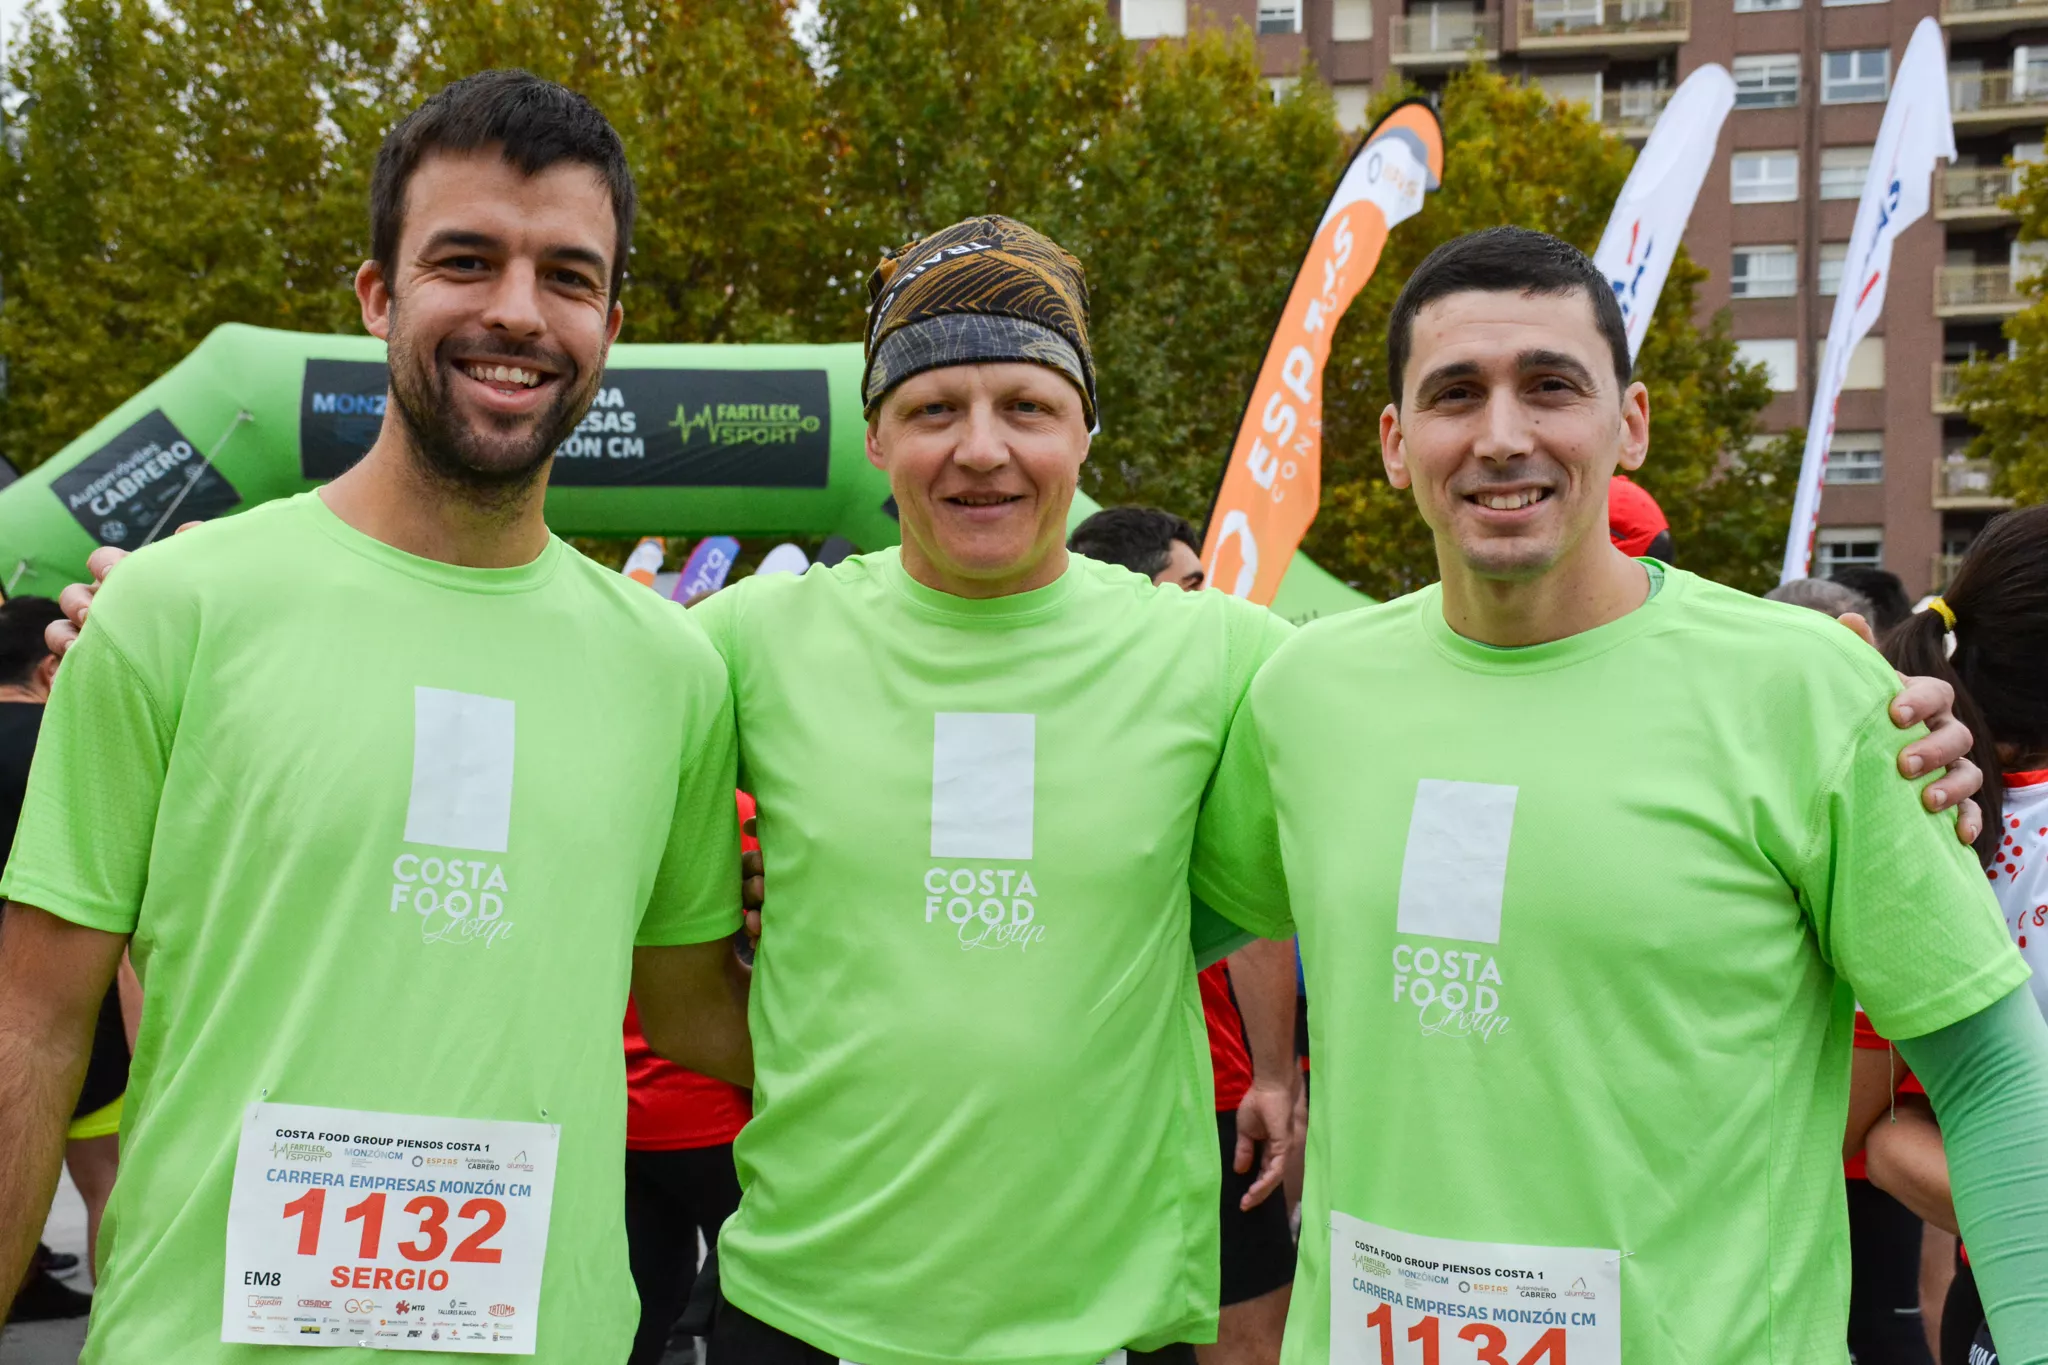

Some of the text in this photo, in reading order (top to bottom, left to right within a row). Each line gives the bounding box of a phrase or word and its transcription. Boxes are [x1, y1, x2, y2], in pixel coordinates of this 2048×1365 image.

[717, 404, 800, 420] FARTLECK
[607, 436, 645, 459] CM
[721, 428, 799, 445] SPORT
[90, 440, 193, 516] CABRERO
[393, 853, 508, 892] COSTA
[924, 867, 1038, 897] COSTA
[390, 884, 504, 921] FOOD
[925, 895, 1034, 926] FOOD
[422, 903, 515, 949] Group
[958, 911, 1046, 953] Group
[1392, 944, 1503, 985] COSTA
[1394, 973, 1499, 1015] FOOD
[1419, 995, 1511, 1044] Group
[276, 1129, 490, 1152] COSTA FOOD GROUP PIENSOS COSTA 1
[290, 1143, 325, 1153] FARTLECK
[290, 1153, 324, 1163] SPORT
[426, 1157, 458, 1165] ESPIAS
[468, 1163, 500, 1171] CABRERO
[266, 1168, 531, 1197] CARRERA EMPRESAS MONZÓN CM
[282, 1187, 507, 1264] 1132
[1355, 1240, 1544, 1280] COSTA FOOD GROUP PIENSOS COSTA 1
[1365, 1266, 1386, 1279] SPORT
[244, 1271, 282, 1287] EM8
[330, 1265, 450, 1291] SERGIO
[1352, 1277, 1403, 1306] CARRERA
[1406, 1295, 1488, 1320] EMPRESAS
[1492, 1308, 1566, 1326] MONZÓN
[1571, 1312, 1596, 1326] CM
[1520, 1290, 1557, 1299] CABRERO
[1366, 1302, 1567, 1365] 1134
